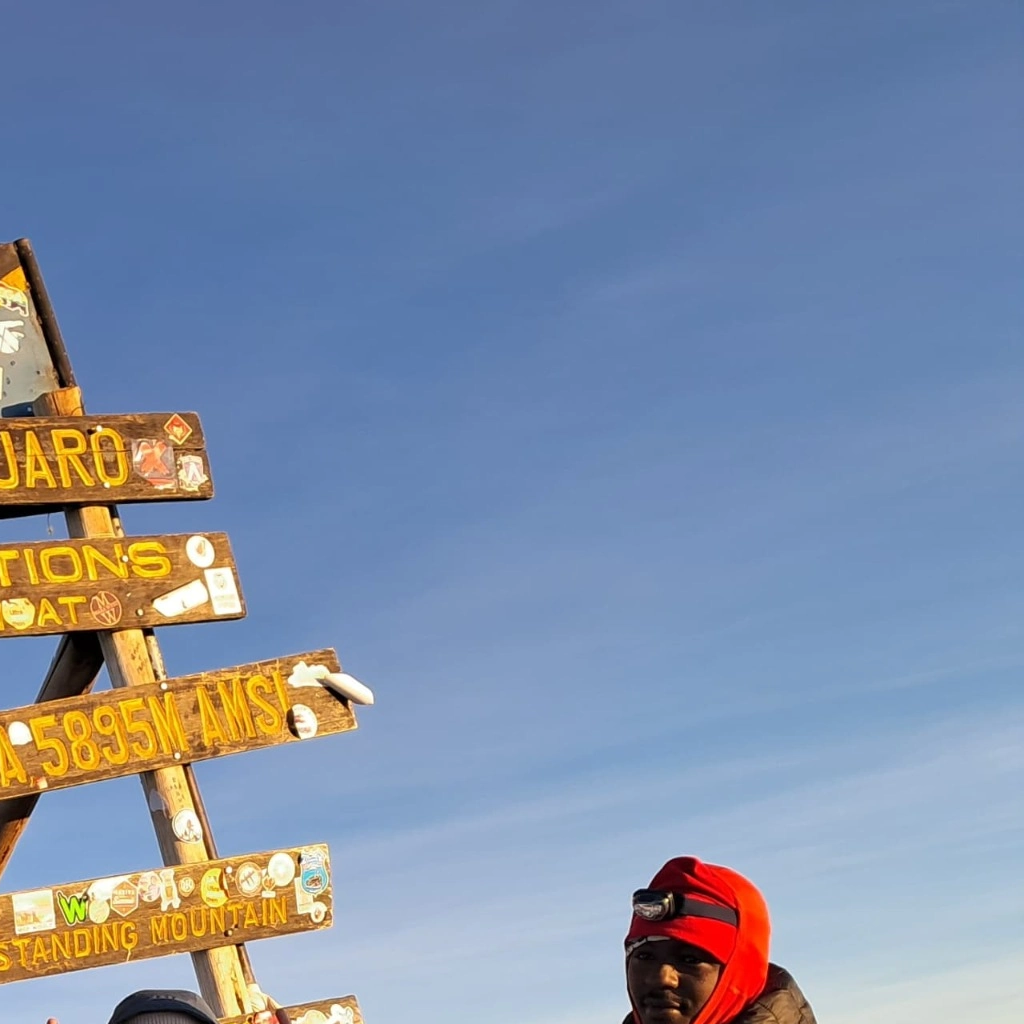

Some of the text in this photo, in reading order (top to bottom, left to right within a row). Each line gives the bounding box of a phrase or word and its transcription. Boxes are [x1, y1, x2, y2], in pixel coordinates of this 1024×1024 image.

[37, 596, 86, 627] AT
[29, 692, 189, 777] 5895M
[151, 895, 287, 945] MOUNTAIN
